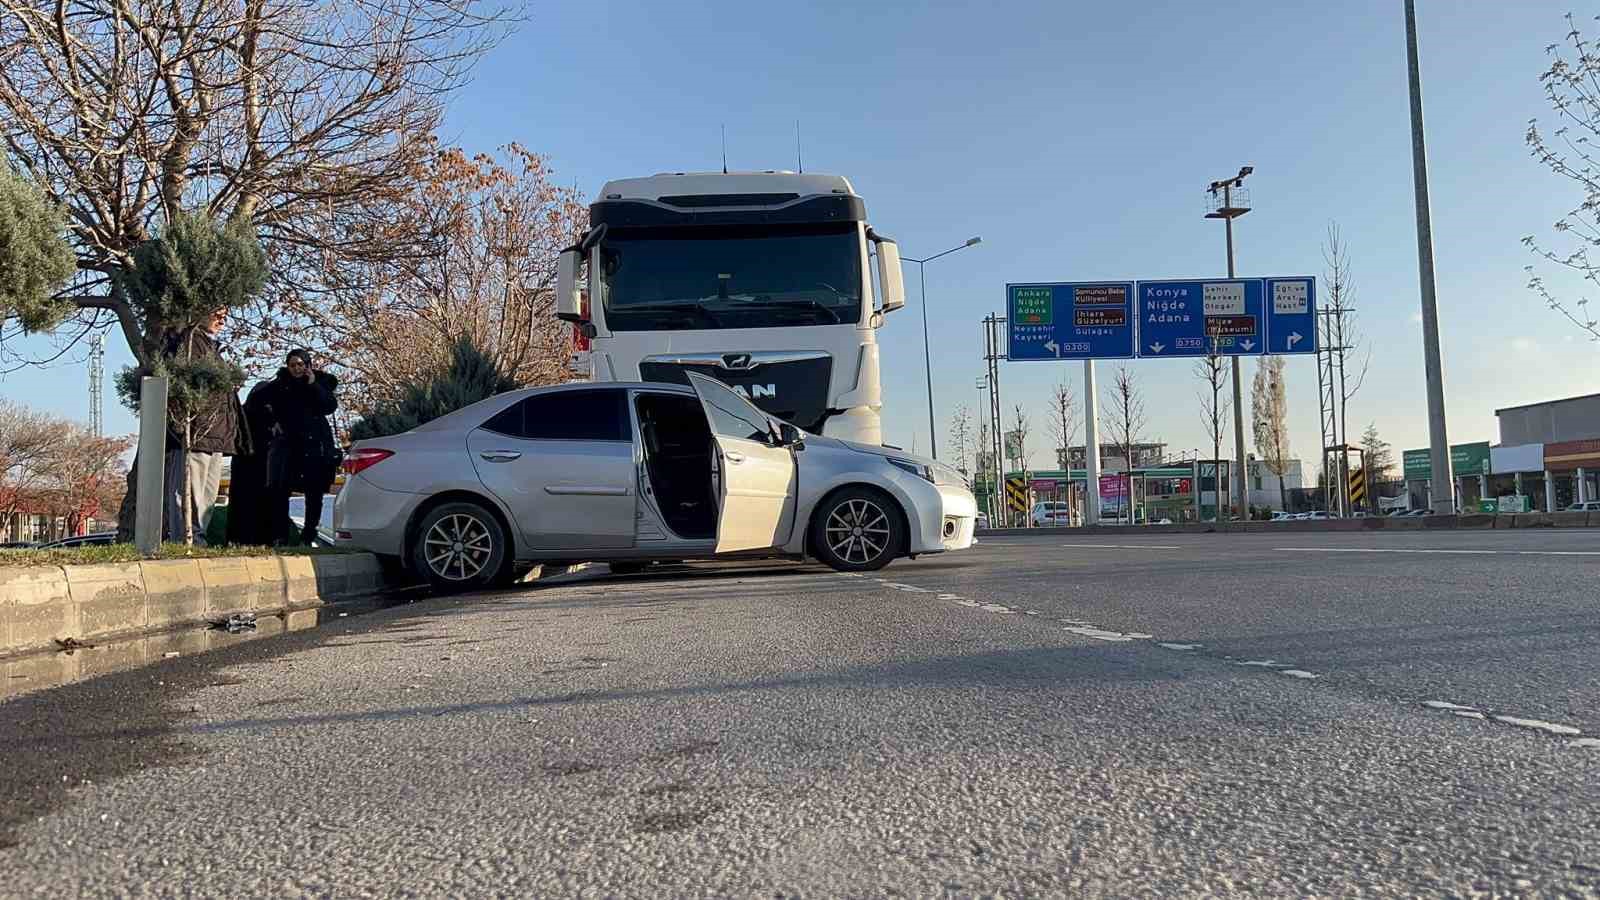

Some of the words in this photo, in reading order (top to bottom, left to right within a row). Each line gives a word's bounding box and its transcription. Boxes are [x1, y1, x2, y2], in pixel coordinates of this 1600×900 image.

[1146, 287, 1188, 299] Konya
[1147, 313, 1191, 323] Adana
[1014, 334, 1051, 342] Kayseri
[732, 383, 776, 400] AN
